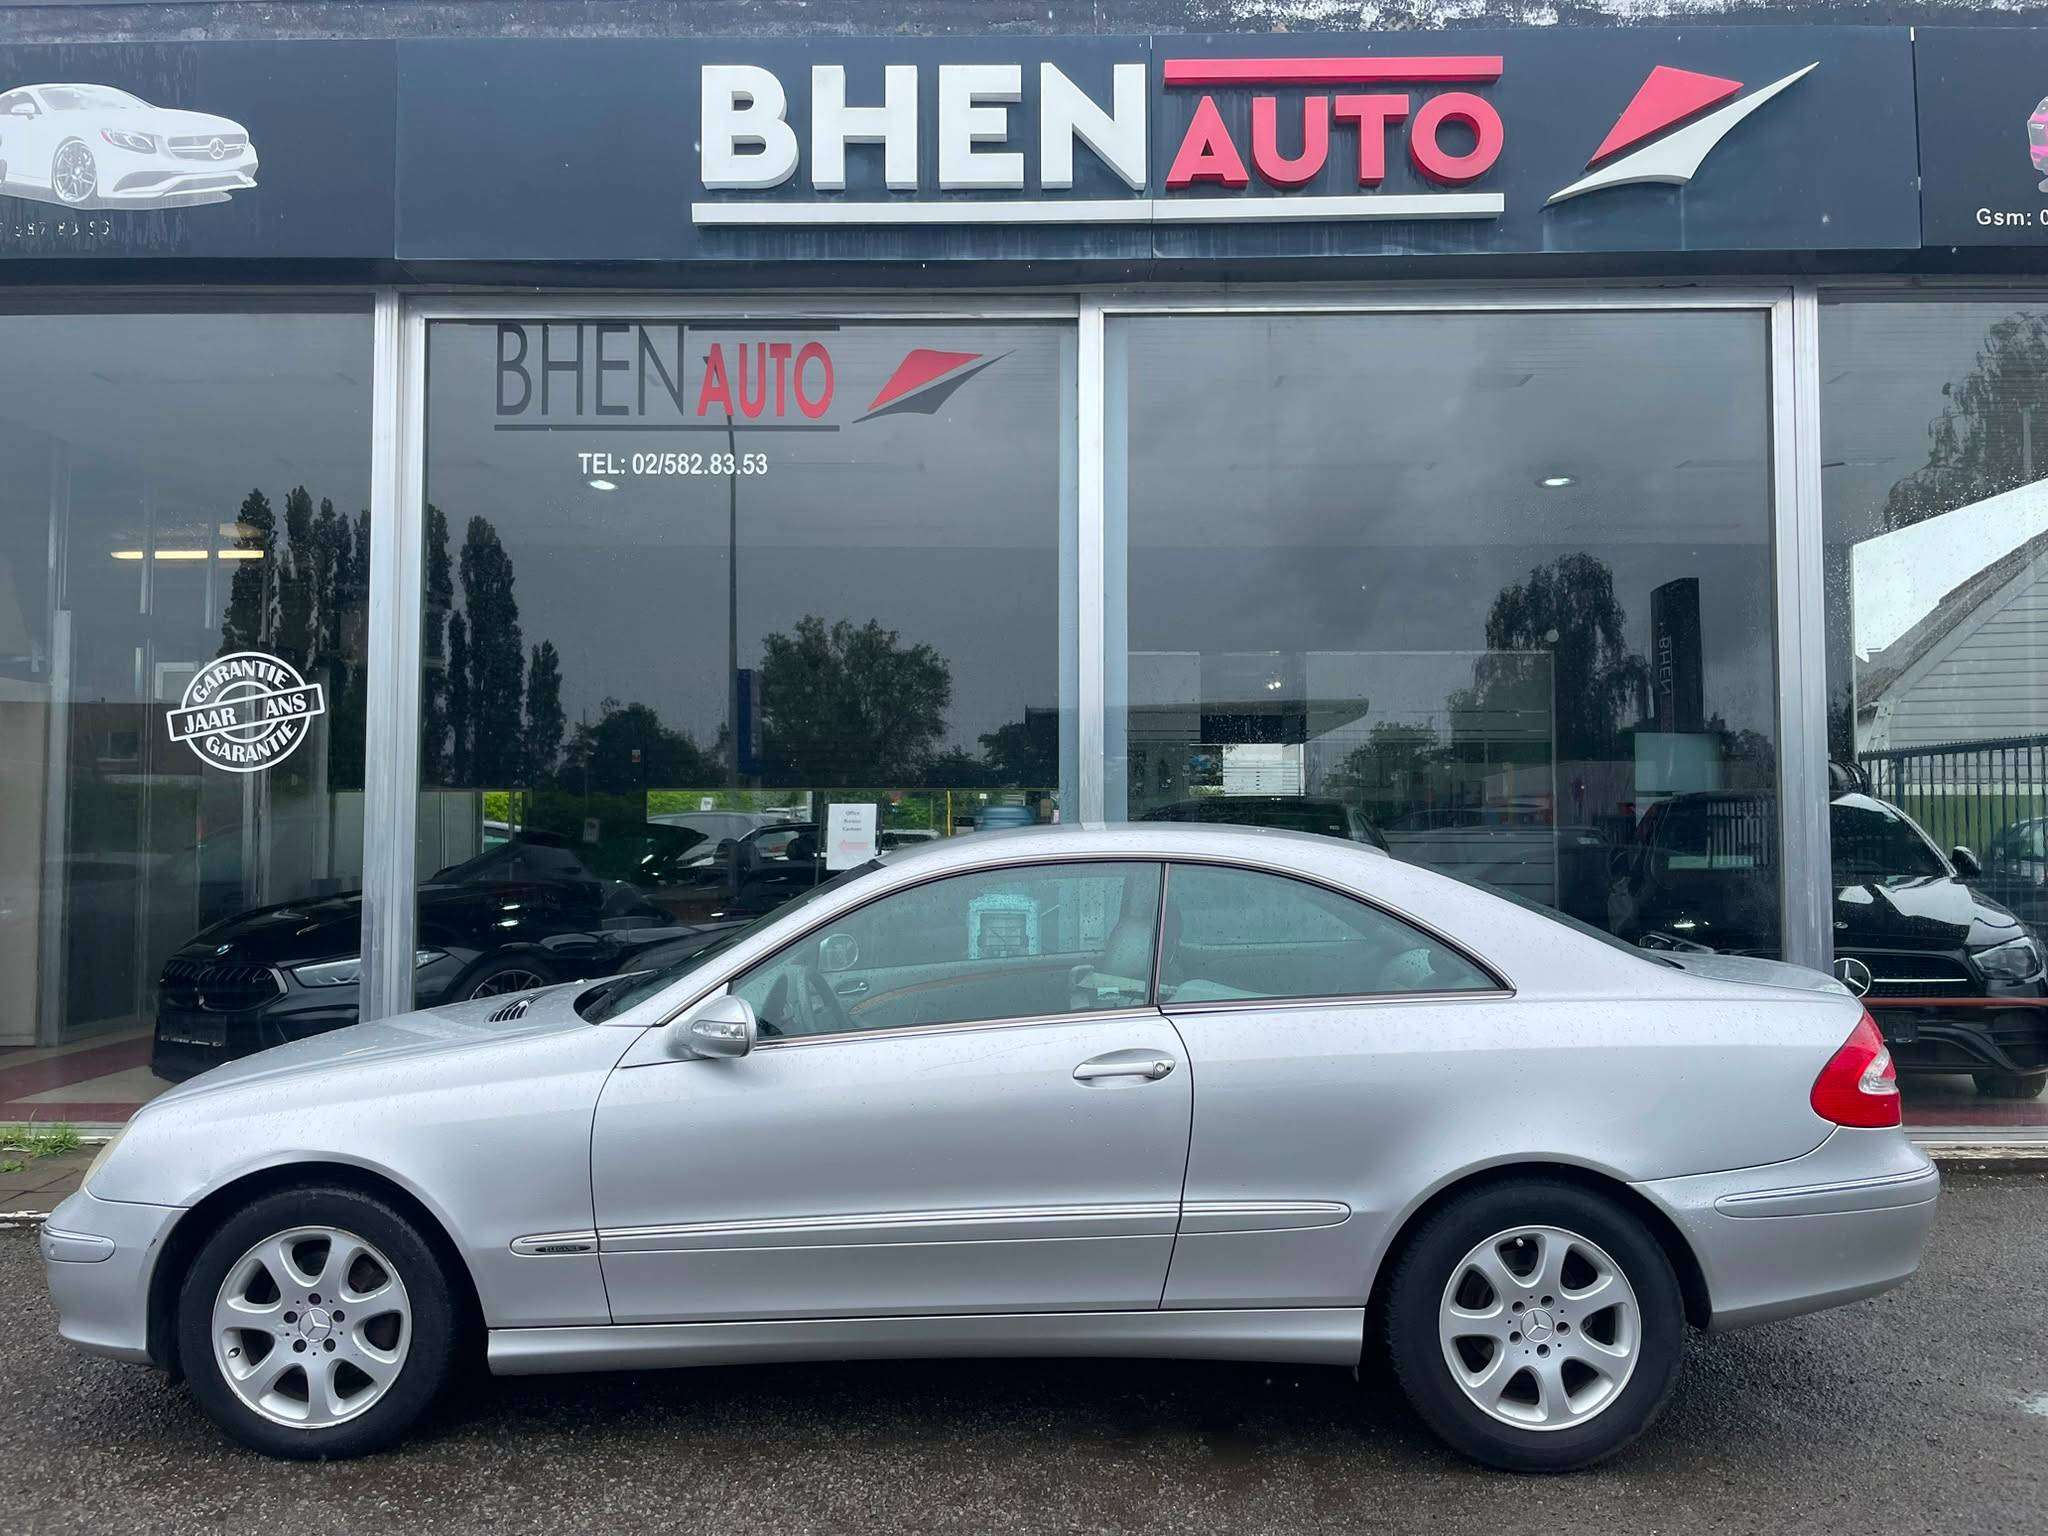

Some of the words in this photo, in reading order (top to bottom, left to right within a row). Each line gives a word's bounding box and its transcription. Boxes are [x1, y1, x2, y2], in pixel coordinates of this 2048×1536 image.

[701, 62, 1148, 192] BHEN
[1166, 91, 1505, 189] AUTO
[1976, 207, 2032, 226] Gsm:
[496, 323, 686, 416] BHEN
[696, 341, 835, 419] AUTO
[578, 453, 626, 475] TEL:
[632, 453, 768, 475] 02/582.83.53
[192, 659, 290, 703] GARANTIE
[184, 707, 237, 734] JAAR
[266, 693, 307, 718] ANS
[205, 720, 298, 763] GARANTIE
